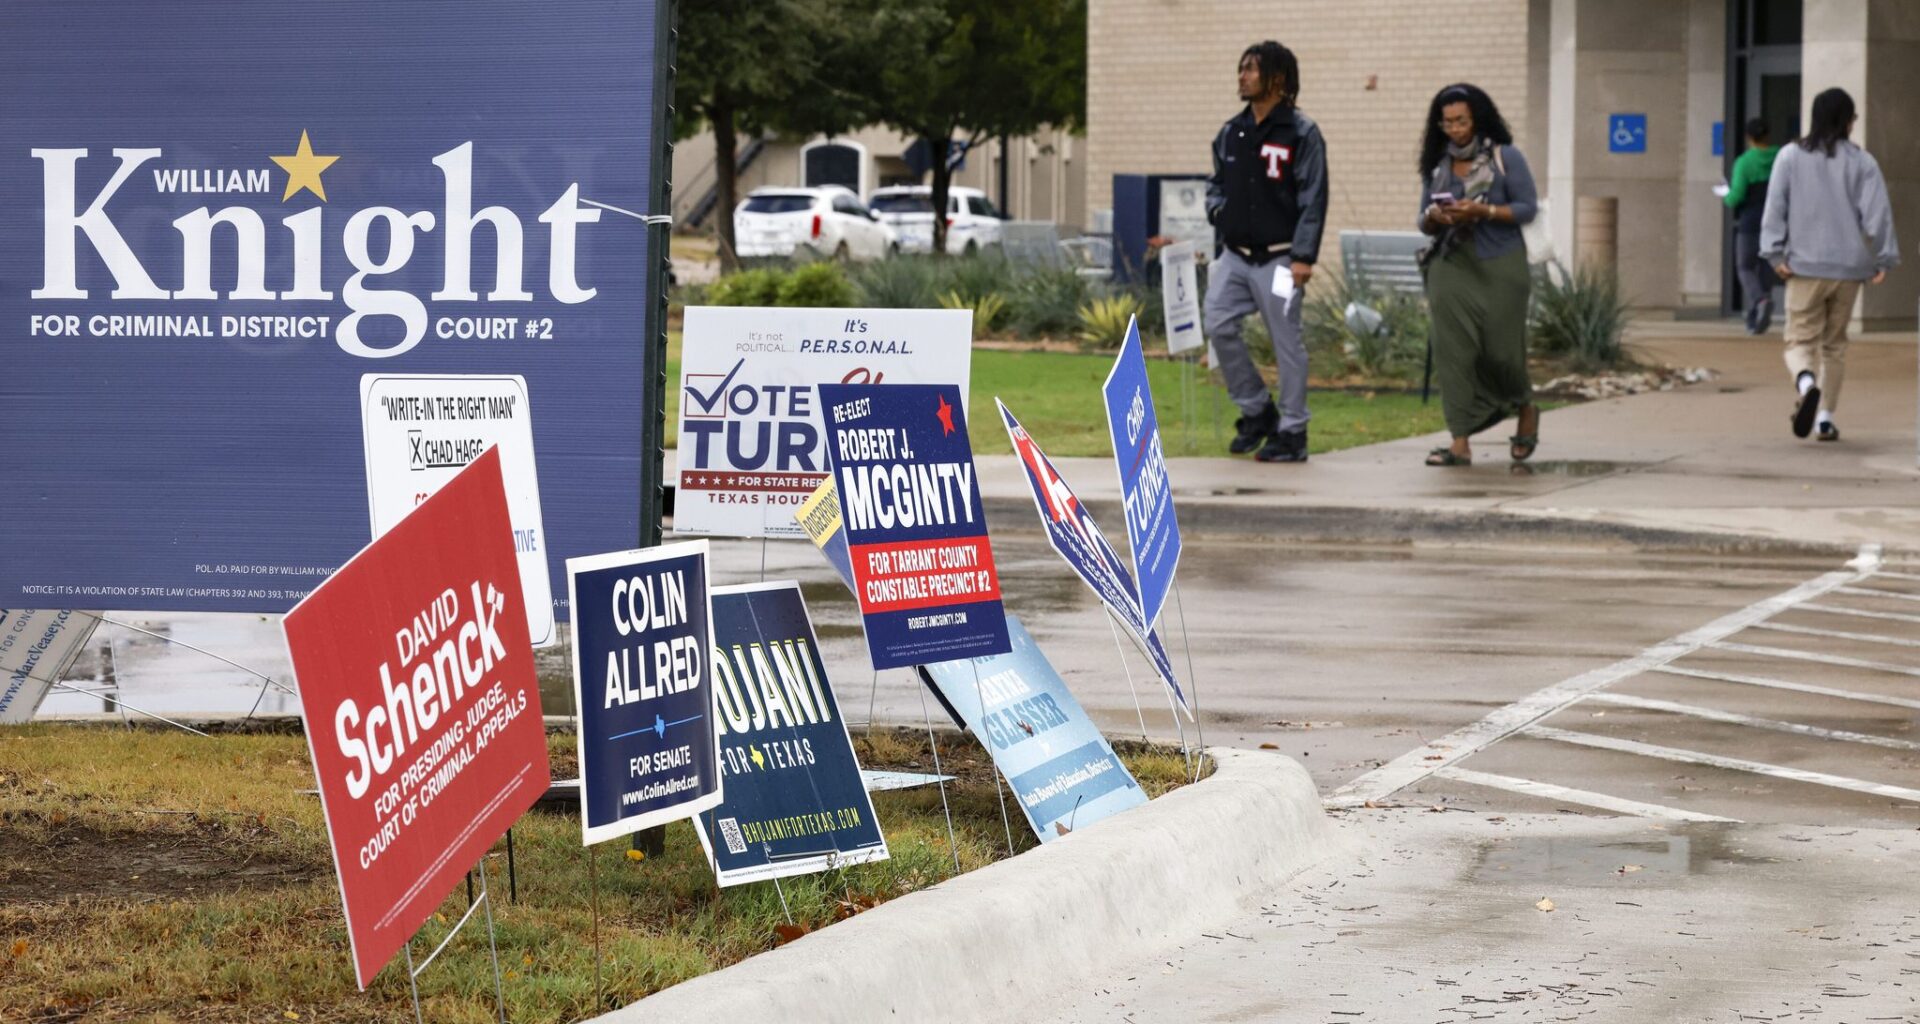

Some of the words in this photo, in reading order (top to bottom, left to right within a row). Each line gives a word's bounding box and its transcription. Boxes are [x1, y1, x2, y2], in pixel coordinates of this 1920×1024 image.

[1260, 142, 1291, 179] T
[153, 169, 270, 194] WILLIAM
[31, 141, 601, 358] Knight
[31, 316, 80, 336] FOR
[89, 316, 213, 338] CRIMINAL
[221, 316, 329, 339] DISTRICT
[436, 318, 517, 340] COURT
[525, 318, 553, 340] #2
[749, 332, 763, 341] It's
[766, 332, 783, 341] not
[844, 319, 868, 333] It's
[800, 340, 913, 354] P.E.R.S.O.N.A.L.
[436, 397, 456, 420] THE
[457, 397, 486, 420] RIGHT
[833, 397, 872, 424] RE-ELECT
[1126, 385, 1145, 447] CHRIS
[425, 440, 453, 464] CHAD
[837, 428, 896, 461] ROBERT
[901, 428, 913, 459] J.
[738, 477, 761, 487] FOR
[764, 477, 799, 487] STATE
[841, 462, 974, 531] MCGINTY
[1126, 428, 1167, 546] TURNER
[708, 493, 759, 505] TEXAS
[514, 529, 537, 552] TIVE
[195, 564, 213, 573] POL.
[215, 565, 229, 573] AD.
[231, 565, 249, 574] PAID
[251, 566, 267, 574] FOR
[269, 566, 279, 574] BY
[280, 566, 315, 575] WILLIAM
[868, 552, 891, 575] FOR
[891, 548, 938, 573] TARRANT
[938, 545, 978, 569] COUNTY
[22, 585, 55, 594] NOTICE:
[56, 586, 64, 594] IT
[66, 586, 73, 594] IS
[75, 586, 81, 594] A
[82, 586, 126, 595] VIOLATION
[128, 587, 139, 595] OF
[141, 587, 164, 596] STATE
[166, 588, 184, 596] LAW
[186, 588, 230, 597] (CHAPTERS
[232, 589, 246, 598] 392
[247, 590, 266, 598] AND
[268, 590, 283, 599] 393,
[867, 575, 928, 603] CONSTABLE
[928, 571, 977, 597] PRECINCT
[978, 570, 991, 592] #2
[612, 570, 687, 636] COLIN
[396, 588, 459, 667] DAVID
[908, 612, 968, 630] ROBERTJMCGINTY.COM
[604, 635, 701, 709] ALLRED
[335, 580, 508, 800] Schenck
[981, 692, 1070, 750] GLASSER
[374, 782, 401, 823] FOR
[401, 720, 464, 796] PRESIDING
[465, 681, 507, 734] JUDGE,
[630, 755, 651, 778] FOR
[653, 745, 691, 772] SENATE
[762, 738, 816, 770] TEXAS
[360, 813, 400, 869] COURT
[402, 795, 418, 826] OF
[420, 743, 475, 808] CRIMINAL
[476, 689, 527, 754] APPEALS
[622, 775, 699, 806] www.ColinAllred.com
[742, 807, 861, 844] BHOJANIFORTEXAS.COM
